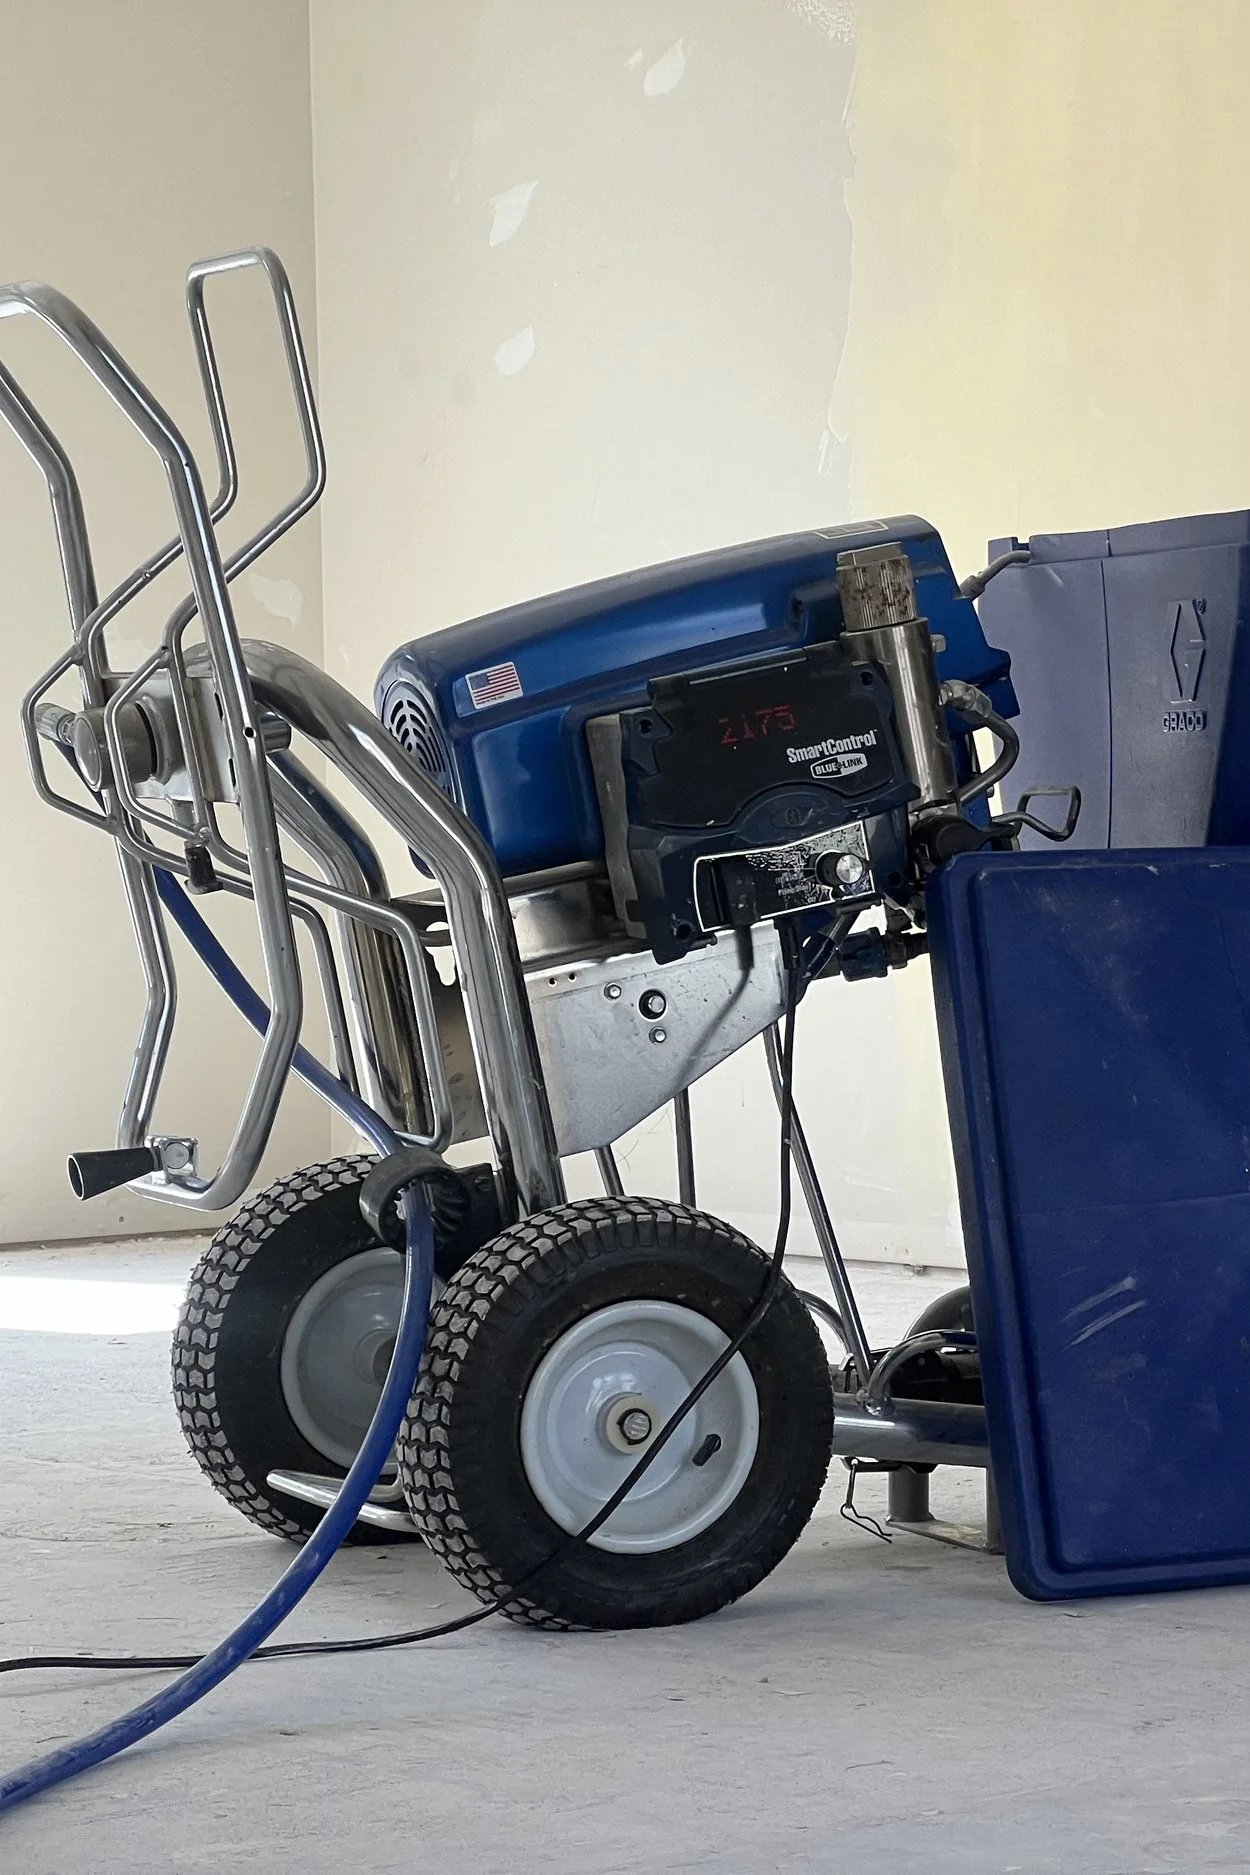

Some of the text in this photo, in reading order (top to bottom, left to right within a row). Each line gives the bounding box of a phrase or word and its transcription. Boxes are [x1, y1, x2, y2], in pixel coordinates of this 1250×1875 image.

[718, 704, 796, 744] 2175
[1163, 711, 1207, 733] GRACO
[786, 731, 877, 763] SmartControl
[815, 756, 864, 775] BLUE LINK
